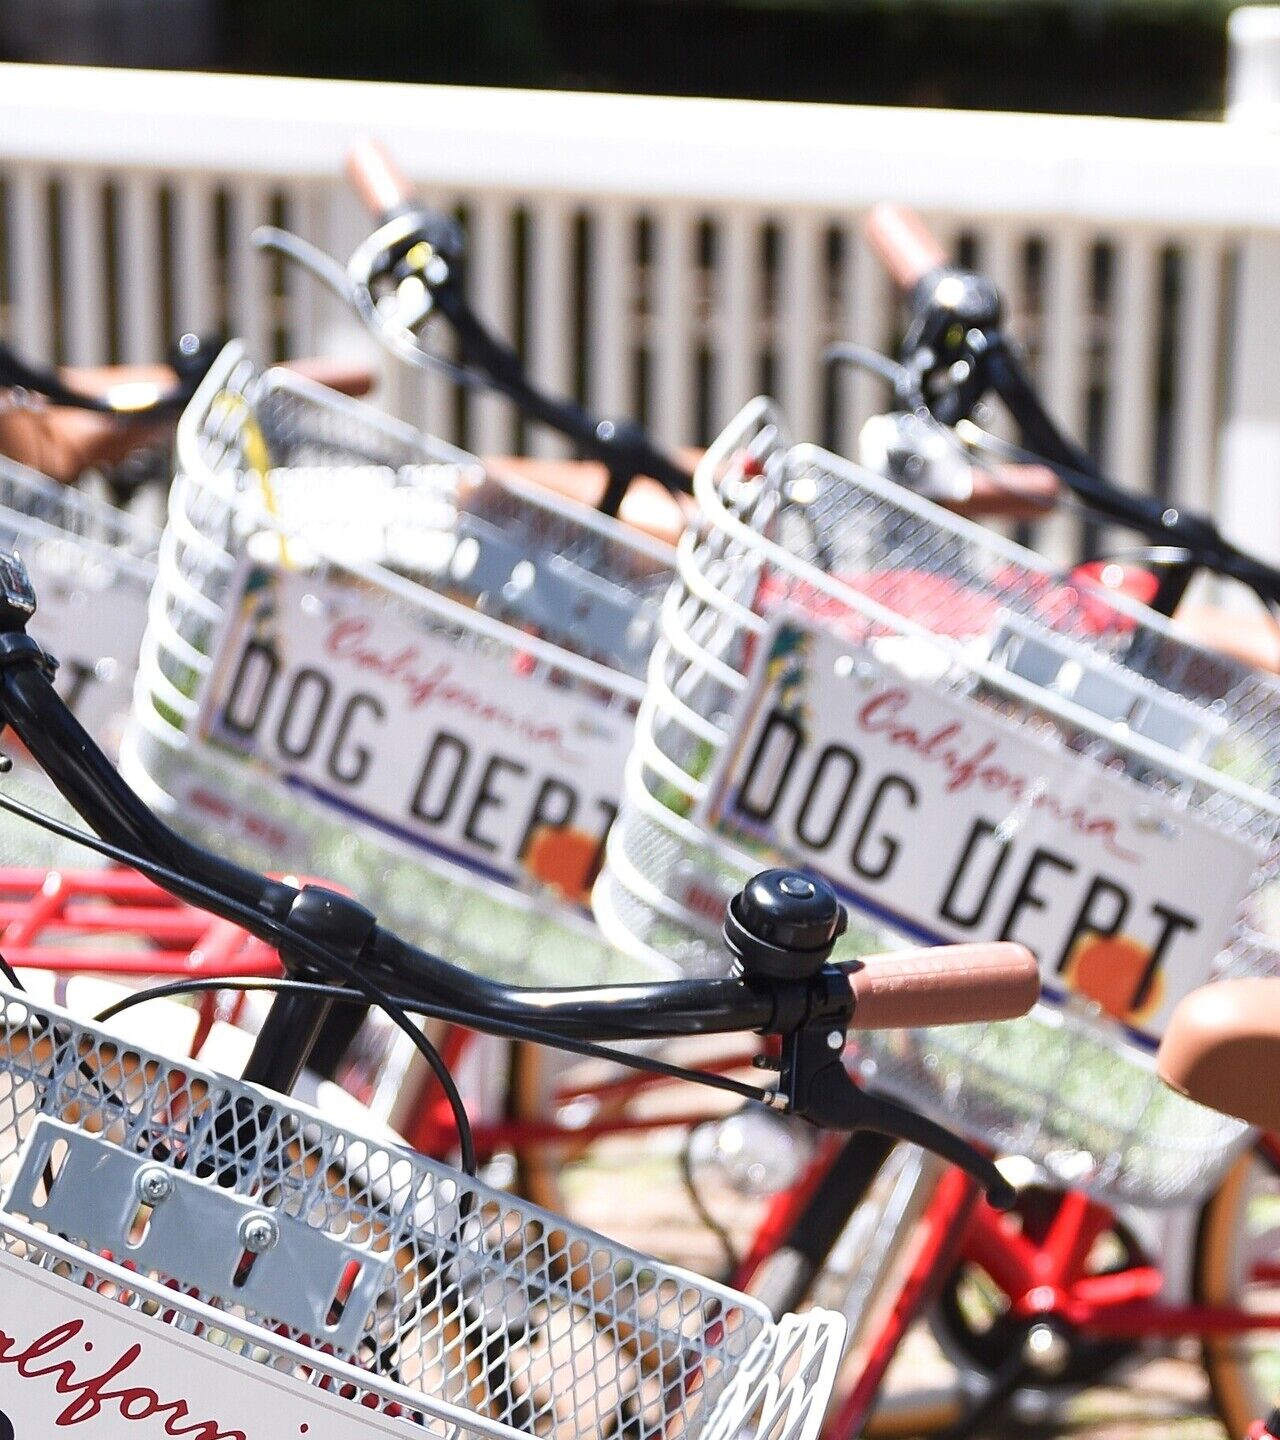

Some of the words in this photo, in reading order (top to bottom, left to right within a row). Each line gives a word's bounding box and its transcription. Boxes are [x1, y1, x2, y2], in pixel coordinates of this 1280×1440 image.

[219, 640, 387, 788] DOG
[410, 731, 619, 891] DEPT
[327, 616, 589, 764] California
[858, 686, 1141, 865] California
[734, 707, 919, 883] DOG
[940, 816, 1201, 1010] DEPT
